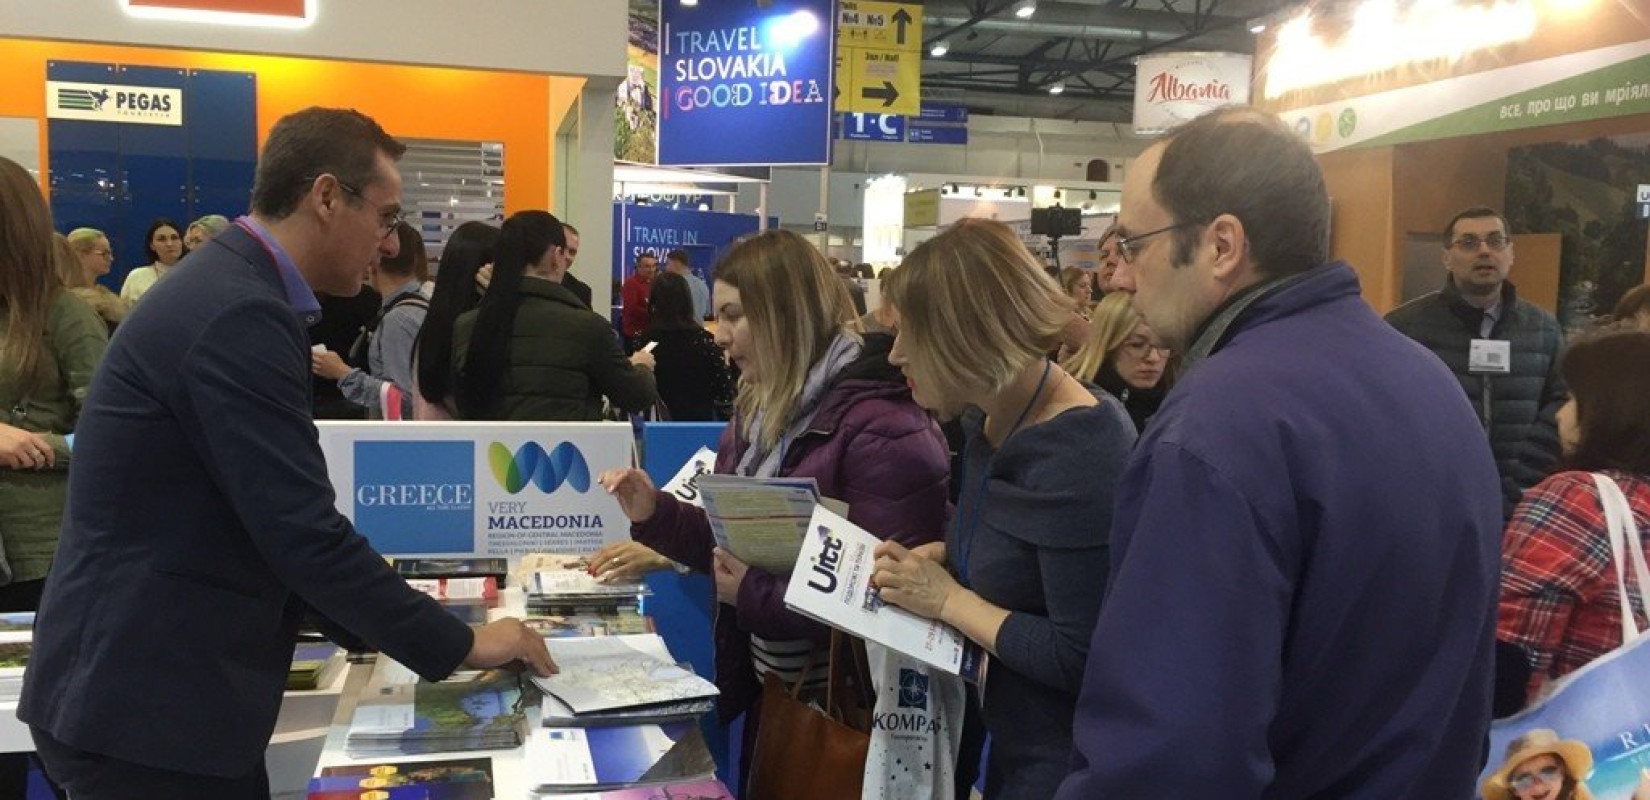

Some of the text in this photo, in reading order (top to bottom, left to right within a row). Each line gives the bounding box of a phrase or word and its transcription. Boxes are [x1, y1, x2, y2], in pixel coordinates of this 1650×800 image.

[676, 27, 762, 54] TRAVEL
[675, 53, 787, 82] SLOVAKIA
[676, 79, 824, 111] GOOD IDEA
[1148, 72, 1230, 102] Albania
[1527, 99, 1551, 117] про
[1555, 95, 1576, 112] що
[1605, 81, 1650, 106] мріял
[116, 91, 171, 111] PEGAS
[633, 226, 679, 245] TRAVEL
[357, 483, 472, 506] GREECE
[488, 501, 527, 514] VERY
[488, 515, 603, 530] MACEDONIA
